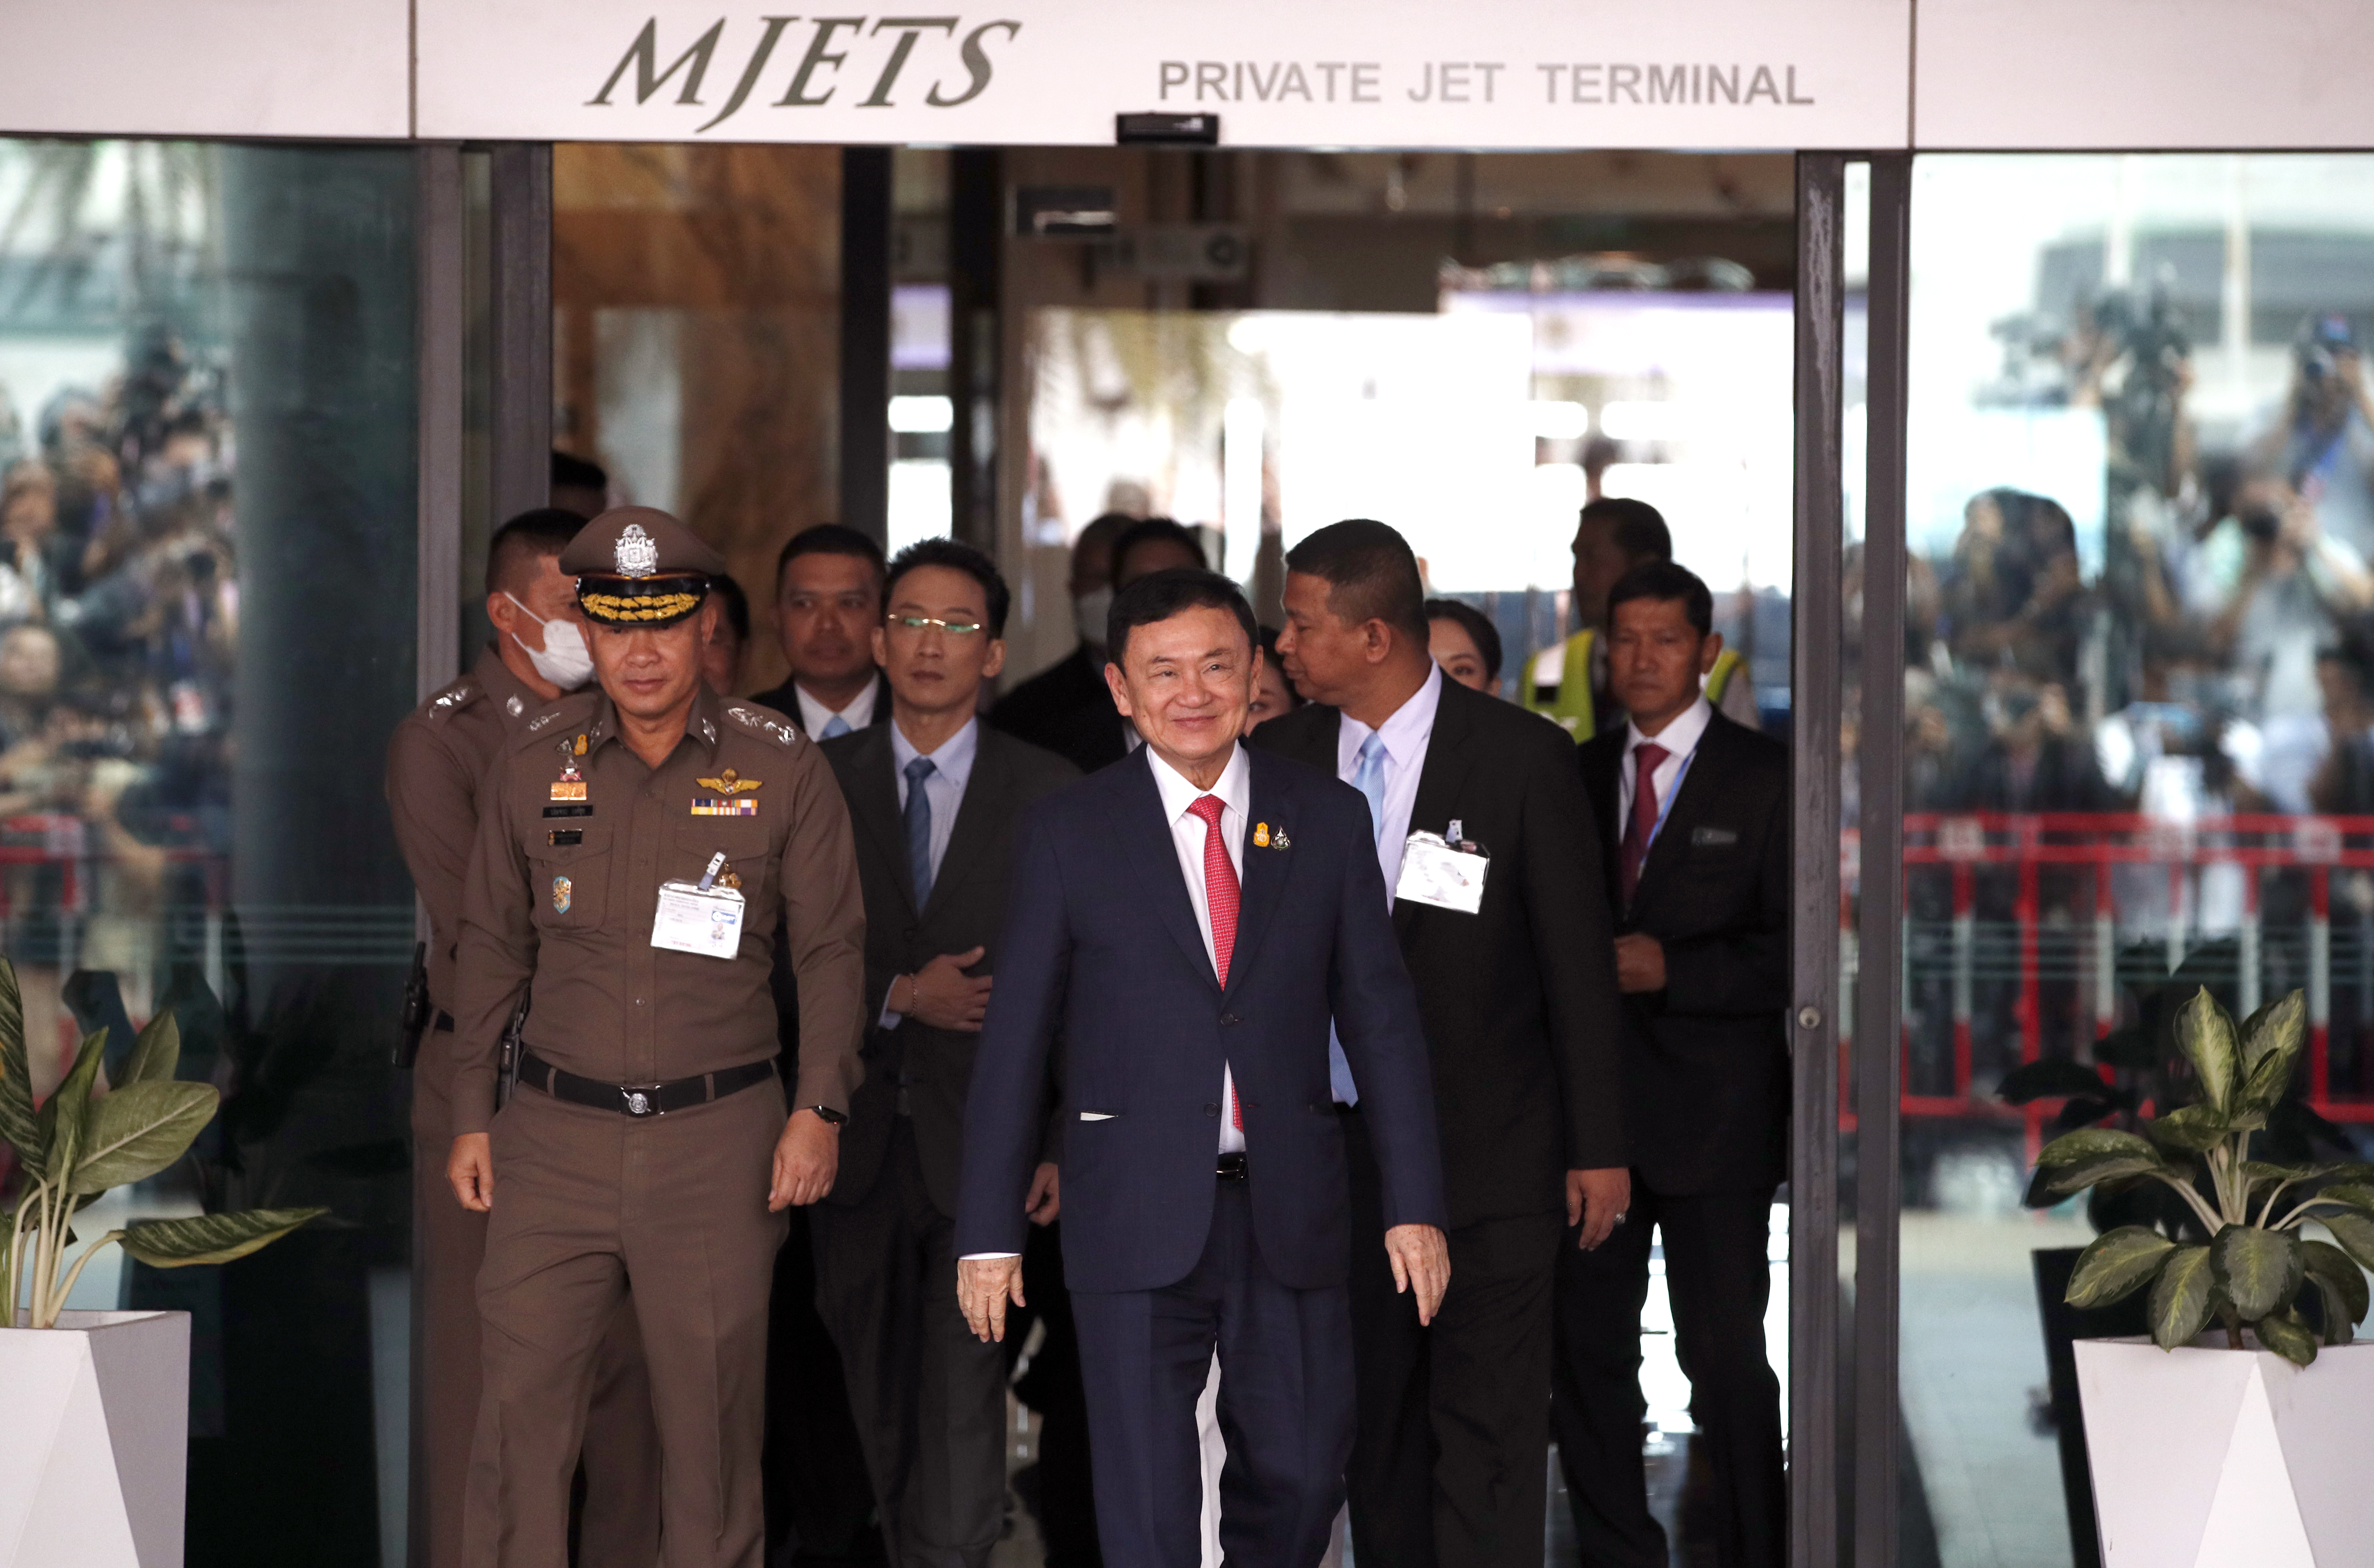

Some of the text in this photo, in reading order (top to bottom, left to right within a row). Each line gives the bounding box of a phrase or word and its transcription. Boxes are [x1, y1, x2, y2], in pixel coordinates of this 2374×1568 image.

[584, 16, 1022, 133] MJETS
[1159, 61, 1815, 105] PRIVATE JET TERMINAL
